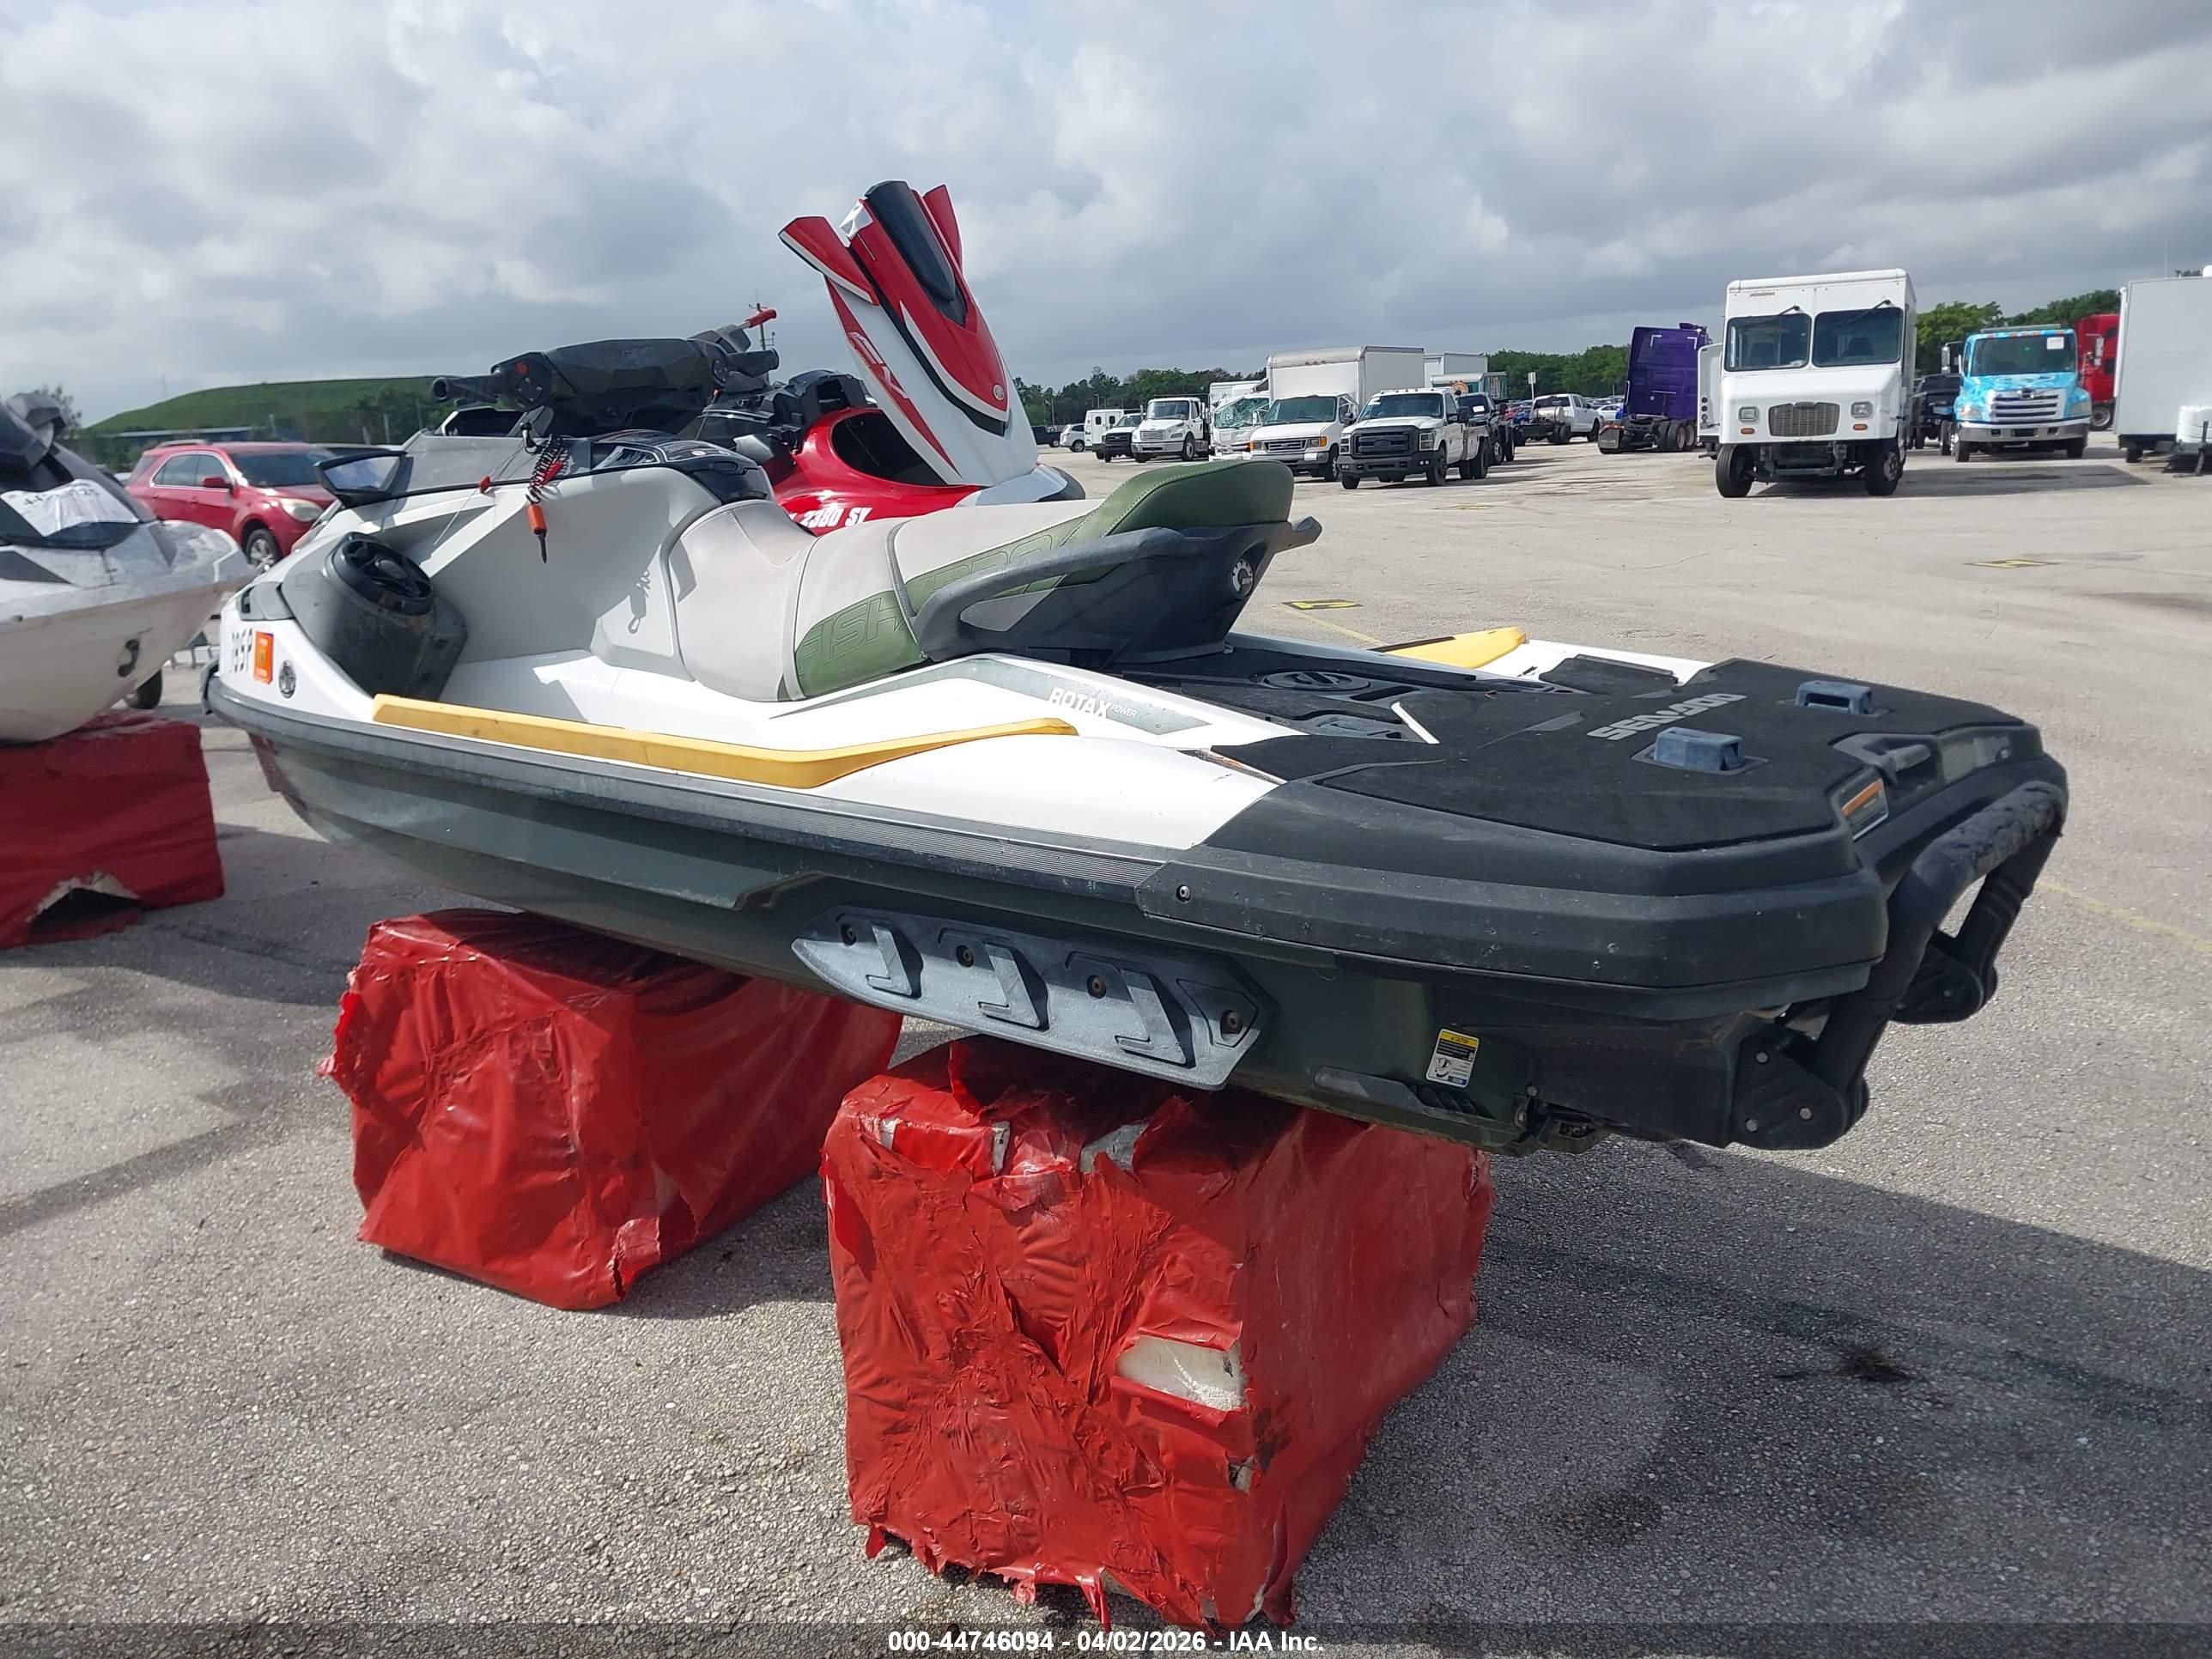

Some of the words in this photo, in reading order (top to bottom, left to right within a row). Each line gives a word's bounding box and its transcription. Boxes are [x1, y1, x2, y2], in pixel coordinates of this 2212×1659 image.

[800, 507, 845, 528] 2380
[845, 507, 873, 527] SY
[1049, 687, 1113, 719] ROTAX
[1111, 702, 1138, 719] POWER
